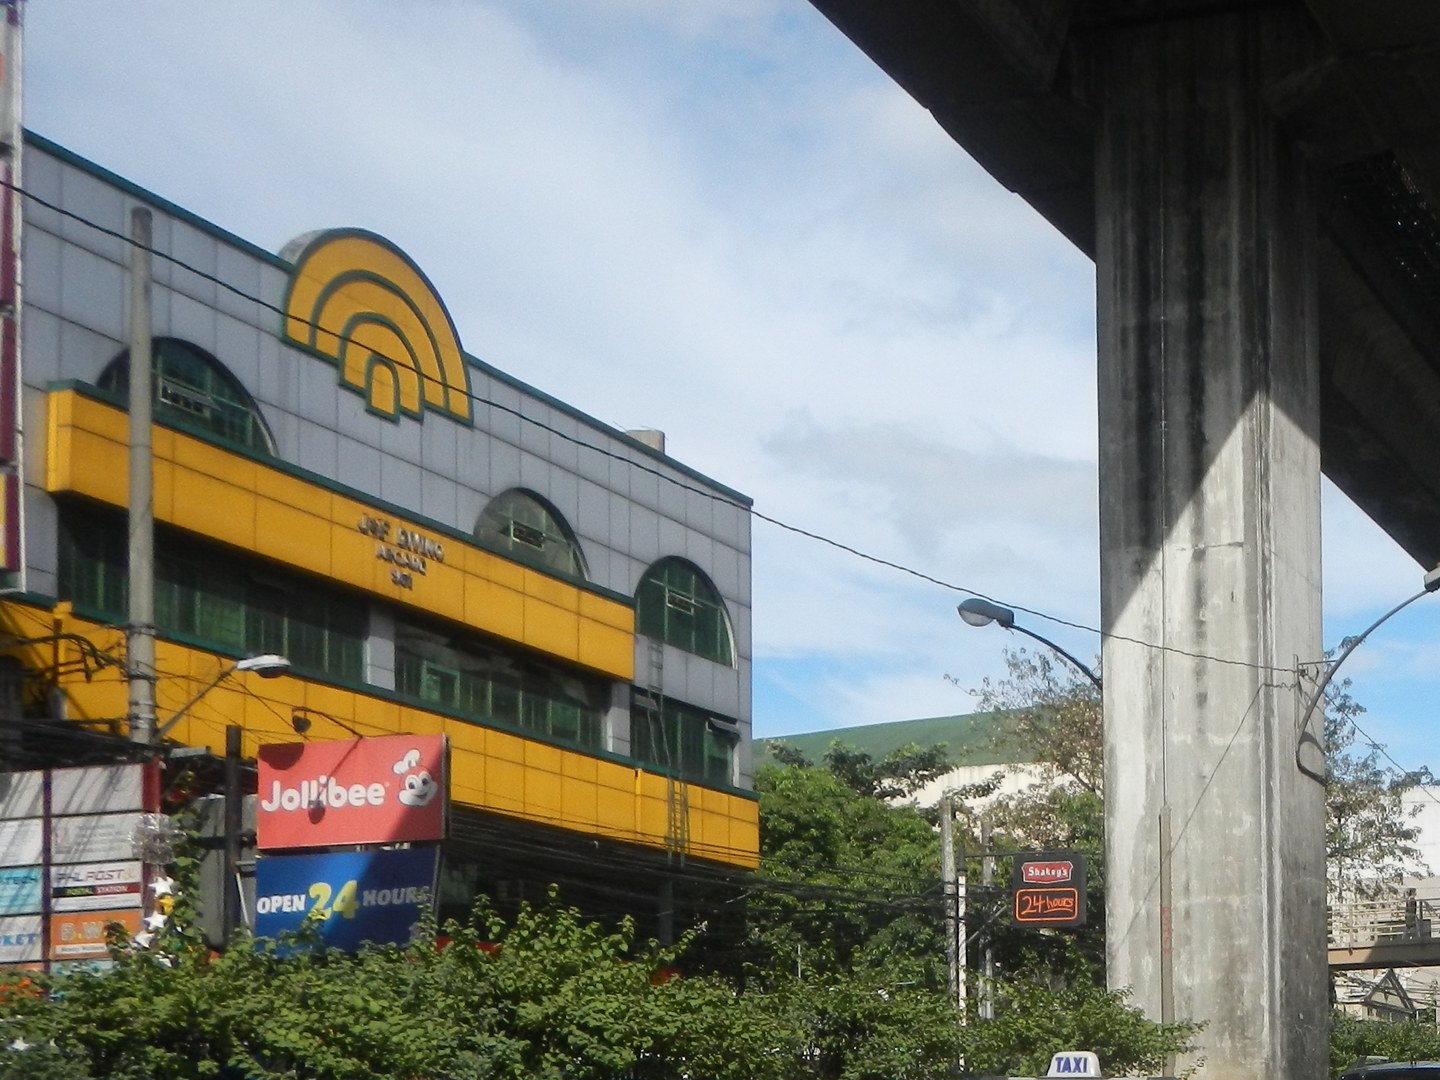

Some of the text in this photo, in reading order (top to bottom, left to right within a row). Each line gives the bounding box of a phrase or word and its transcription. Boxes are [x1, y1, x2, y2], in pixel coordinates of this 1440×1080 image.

[260, 775, 386, 813] Jollibee
[1028, 866, 1068, 878] Shakey's
[256, 894, 306, 914] OPEN
[308, 879, 360, 920] 24
[1021, 895, 1074, 915] 24 hours
[0, 933, 39, 946] KET
[1055, 1057, 1088, 1073] TAXI
